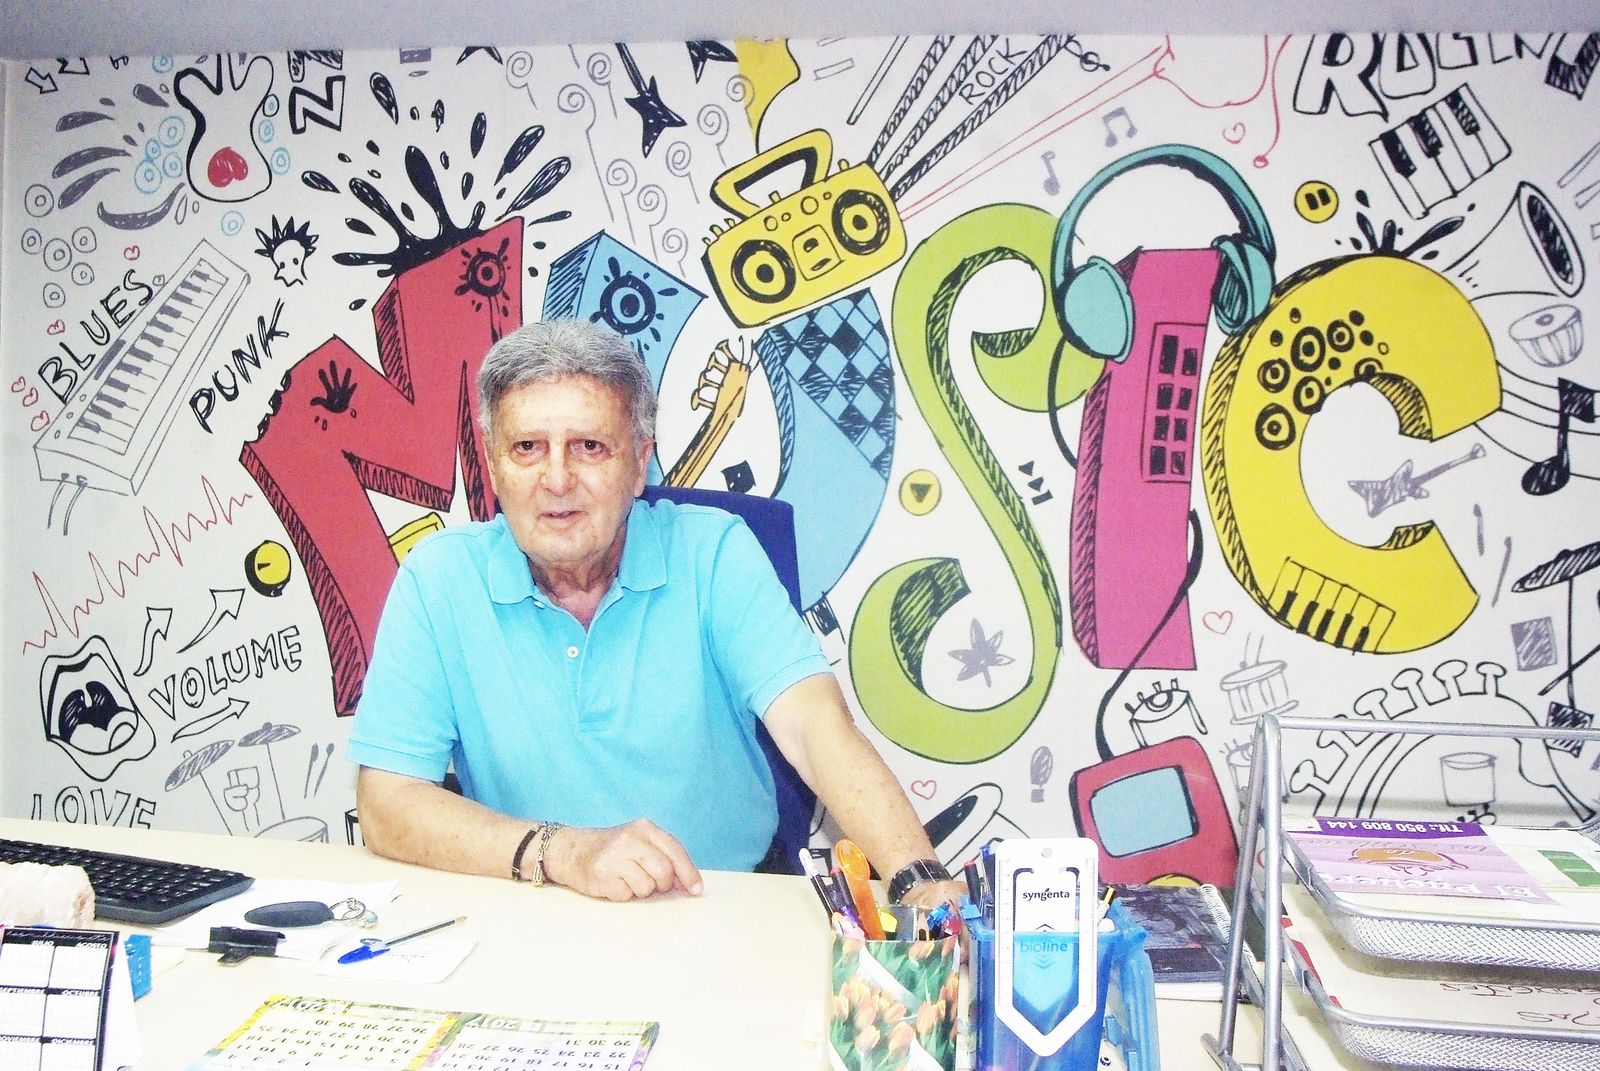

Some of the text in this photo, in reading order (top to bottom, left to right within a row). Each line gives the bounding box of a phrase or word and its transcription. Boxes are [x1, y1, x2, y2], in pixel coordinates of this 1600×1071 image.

[958, 37, 1028, 106] ROCK
[38, 268, 154, 407] BLUES
[188, 297, 290, 434] PUNK
[148, 625, 302, 721] VOLUME
[1326, 820, 1358, 831] 144
[1361, 821, 1393, 832] 809
[1395, 823, 1428, 834] 950
[1022, 888, 1071, 902] syngenta
[1490, 885, 1537, 898] El
[75, 942, 108, 950] AGOSTO
[1020, 941, 1069, 953] bioline
